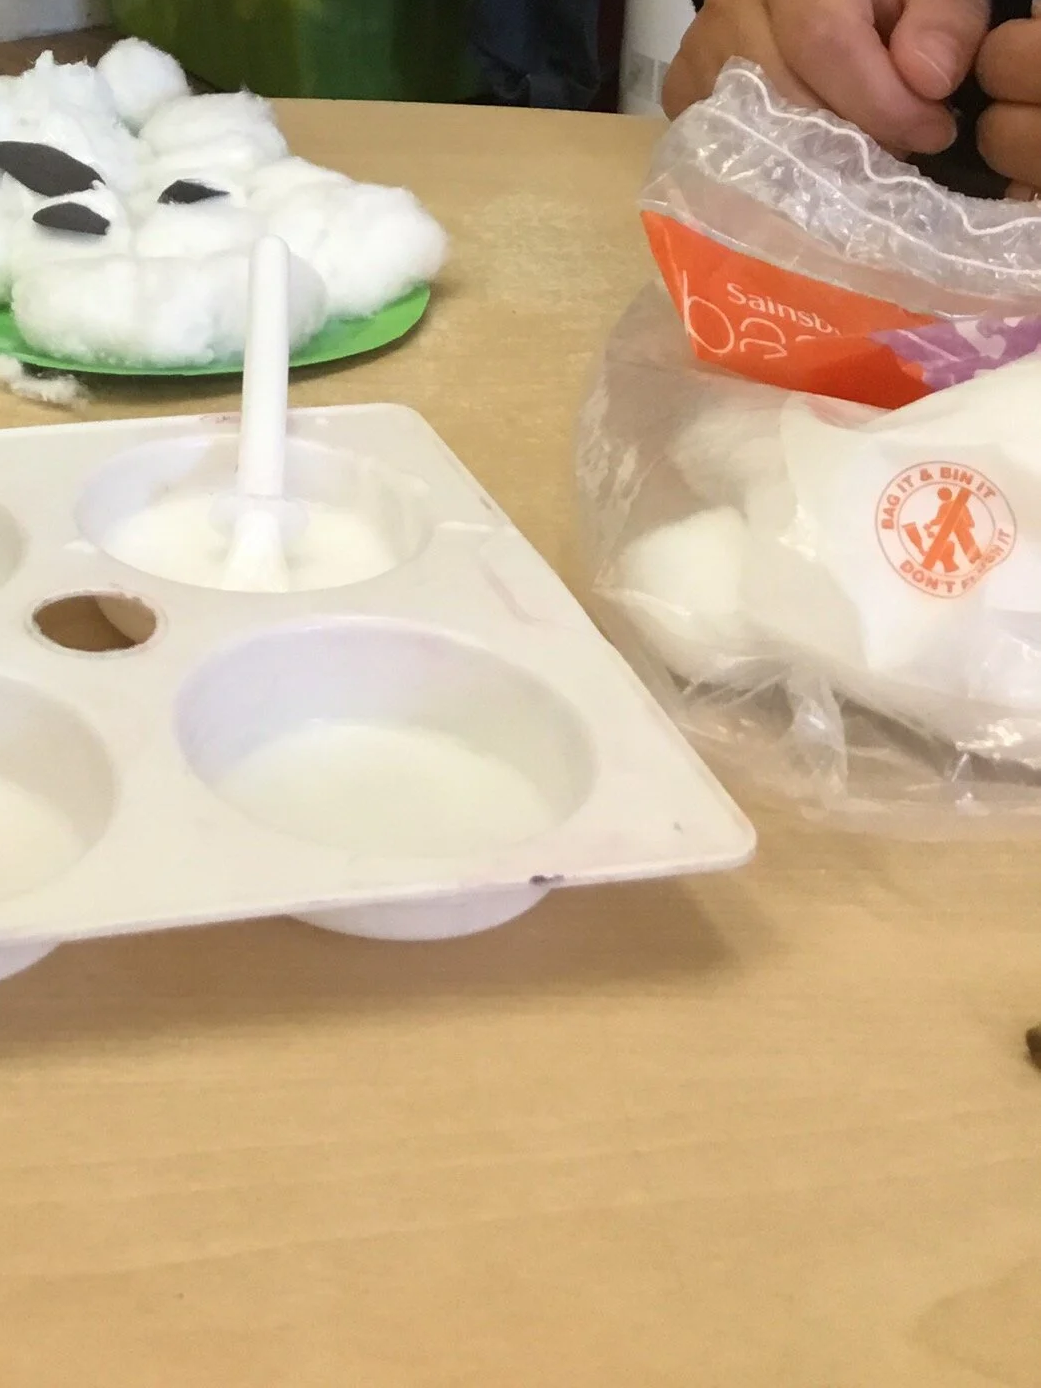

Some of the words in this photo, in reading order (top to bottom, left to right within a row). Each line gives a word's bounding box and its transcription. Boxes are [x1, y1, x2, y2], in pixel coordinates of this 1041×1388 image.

[881, 493, 901, 530] BAG
[897, 474, 915, 493] IT
[919, 468, 934, 482] &
[940, 466, 975, 485] BIN
[976, 482, 997, 499] IT
[899, 559, 956, 594] DON'T
[997, 527, 1012, 546] IT
